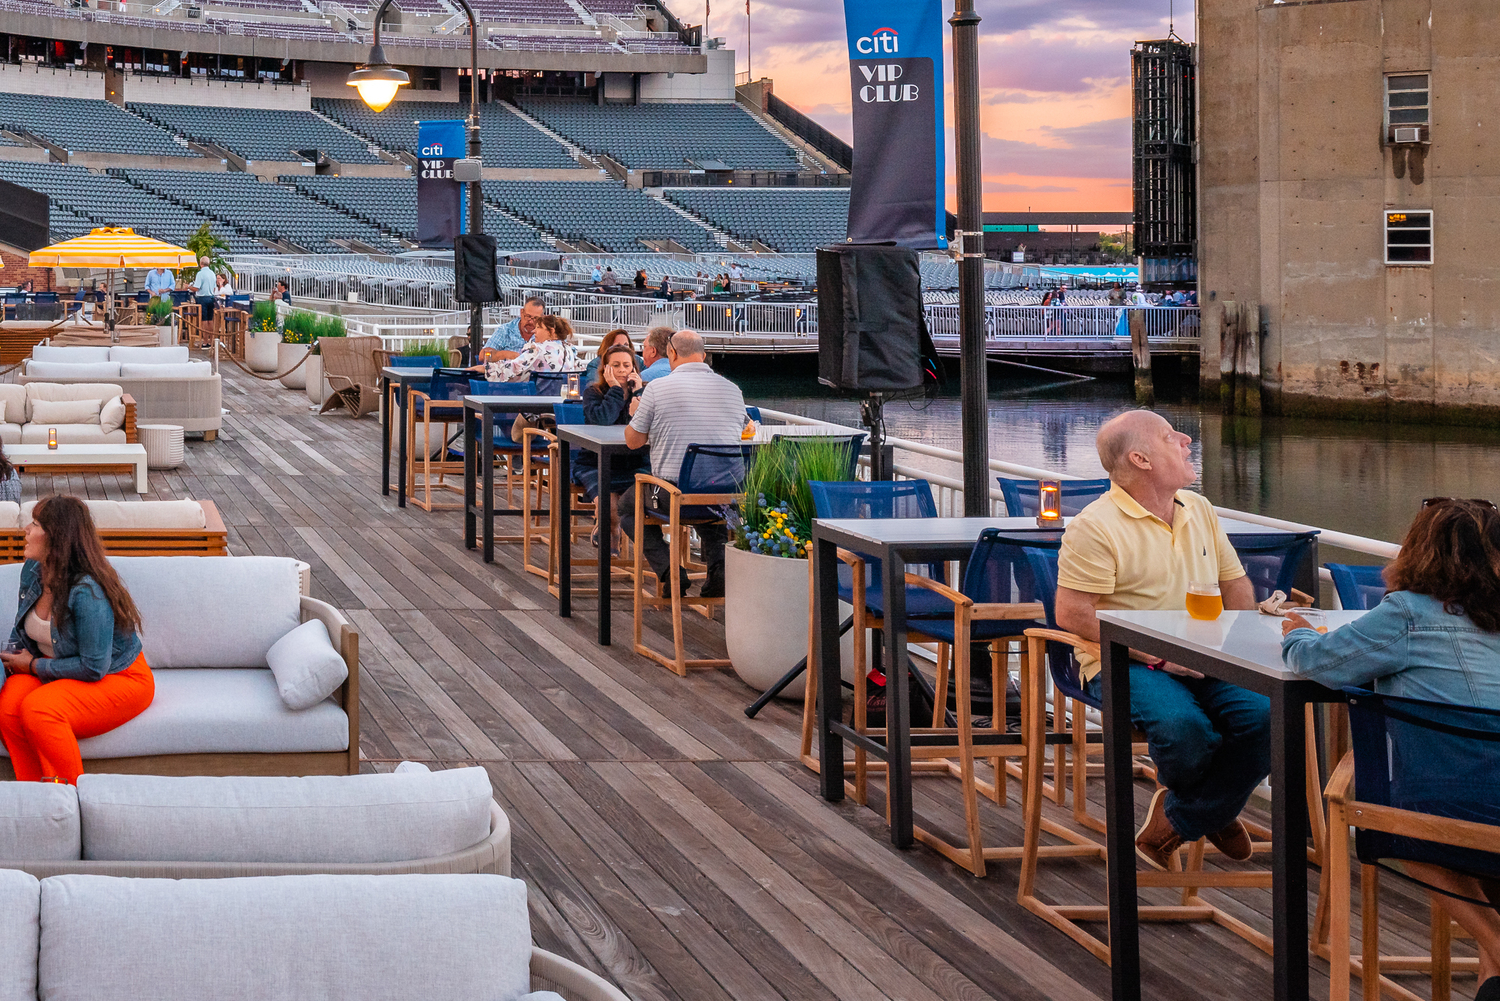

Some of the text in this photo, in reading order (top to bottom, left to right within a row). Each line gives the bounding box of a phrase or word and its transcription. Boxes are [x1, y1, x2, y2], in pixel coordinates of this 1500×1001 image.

[856, 29, 899, 54] citi
[858, 64, 903, 83] VIP
[859, 84, 920, 103] CLUB
[421, 144, 443, 156] citi
[421, 160, 446, 169] VIP
